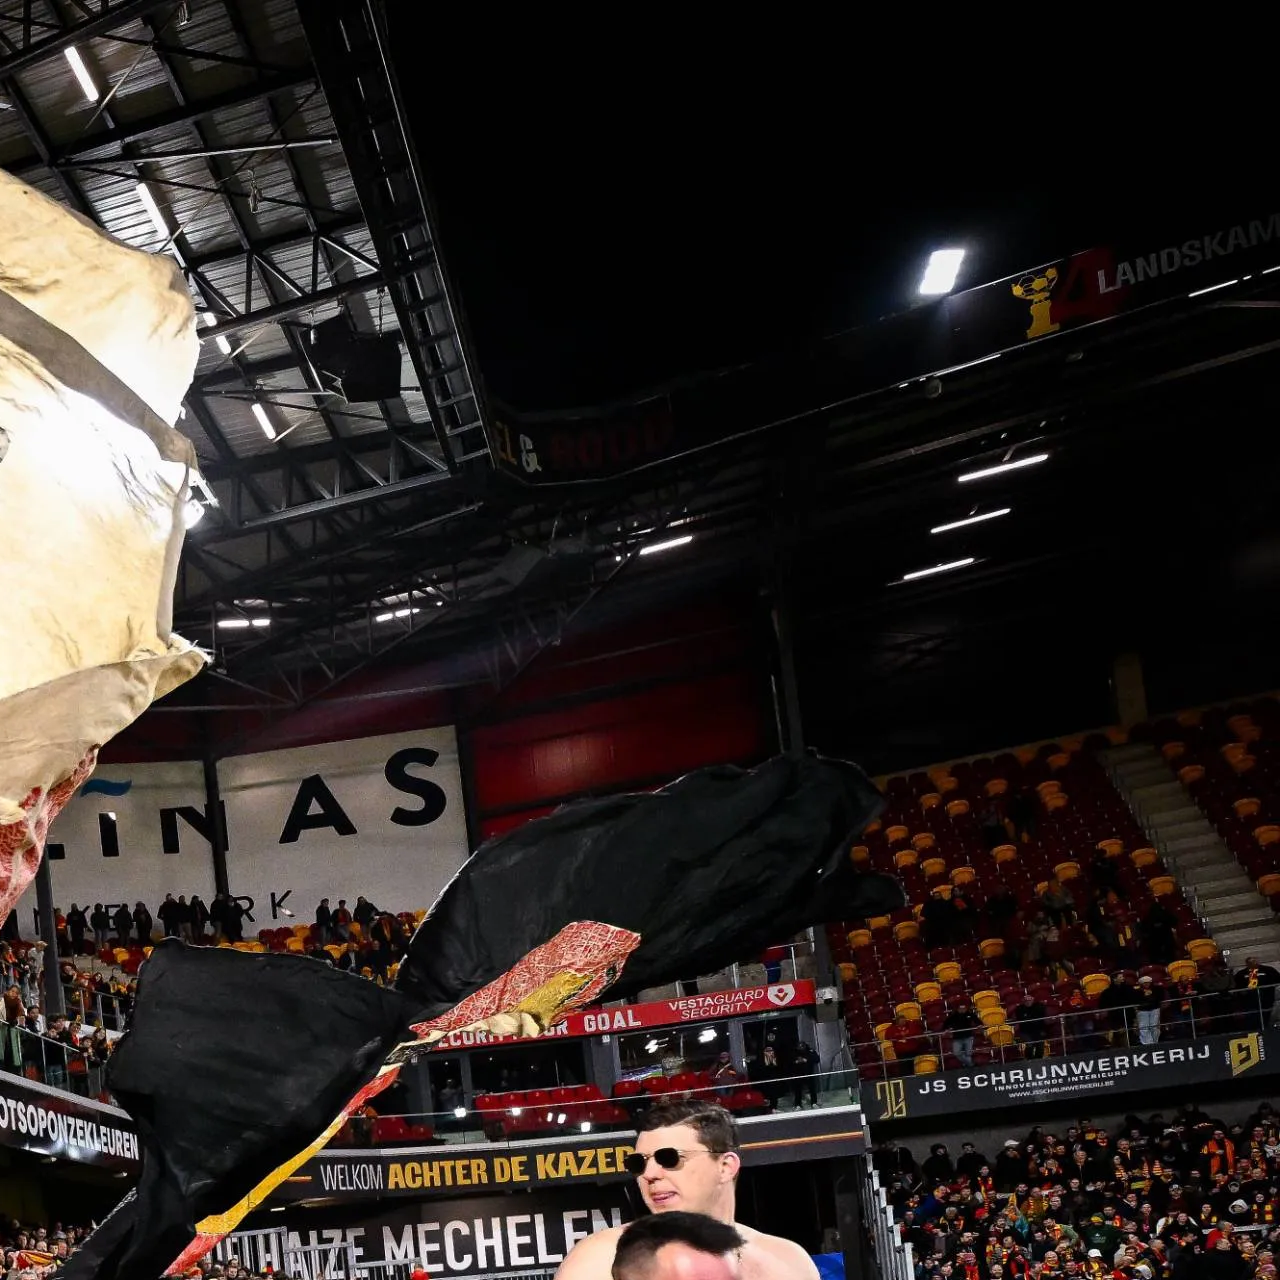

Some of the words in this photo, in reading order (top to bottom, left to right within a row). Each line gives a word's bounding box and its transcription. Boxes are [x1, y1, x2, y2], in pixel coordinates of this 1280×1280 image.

[47, 747, 447, 860] INAS
[668, 988, 766, 1013] VESTAGUARD
[680, 1000, 754, 1021] SECURITY
[583, 1011, 643, 1033] GOAL
[918, 1078, 947, 1096] JS
[957, 1045, 1211, 1090] SCHRIJNWERKERIJ
[320, 1163, 384, 1192] WELKOM
[387, 1156, 488, 1190] ACHTER
[493, 1154, 530, 1184] DE
[382, 1208, 623, 1276] MECHELEN
